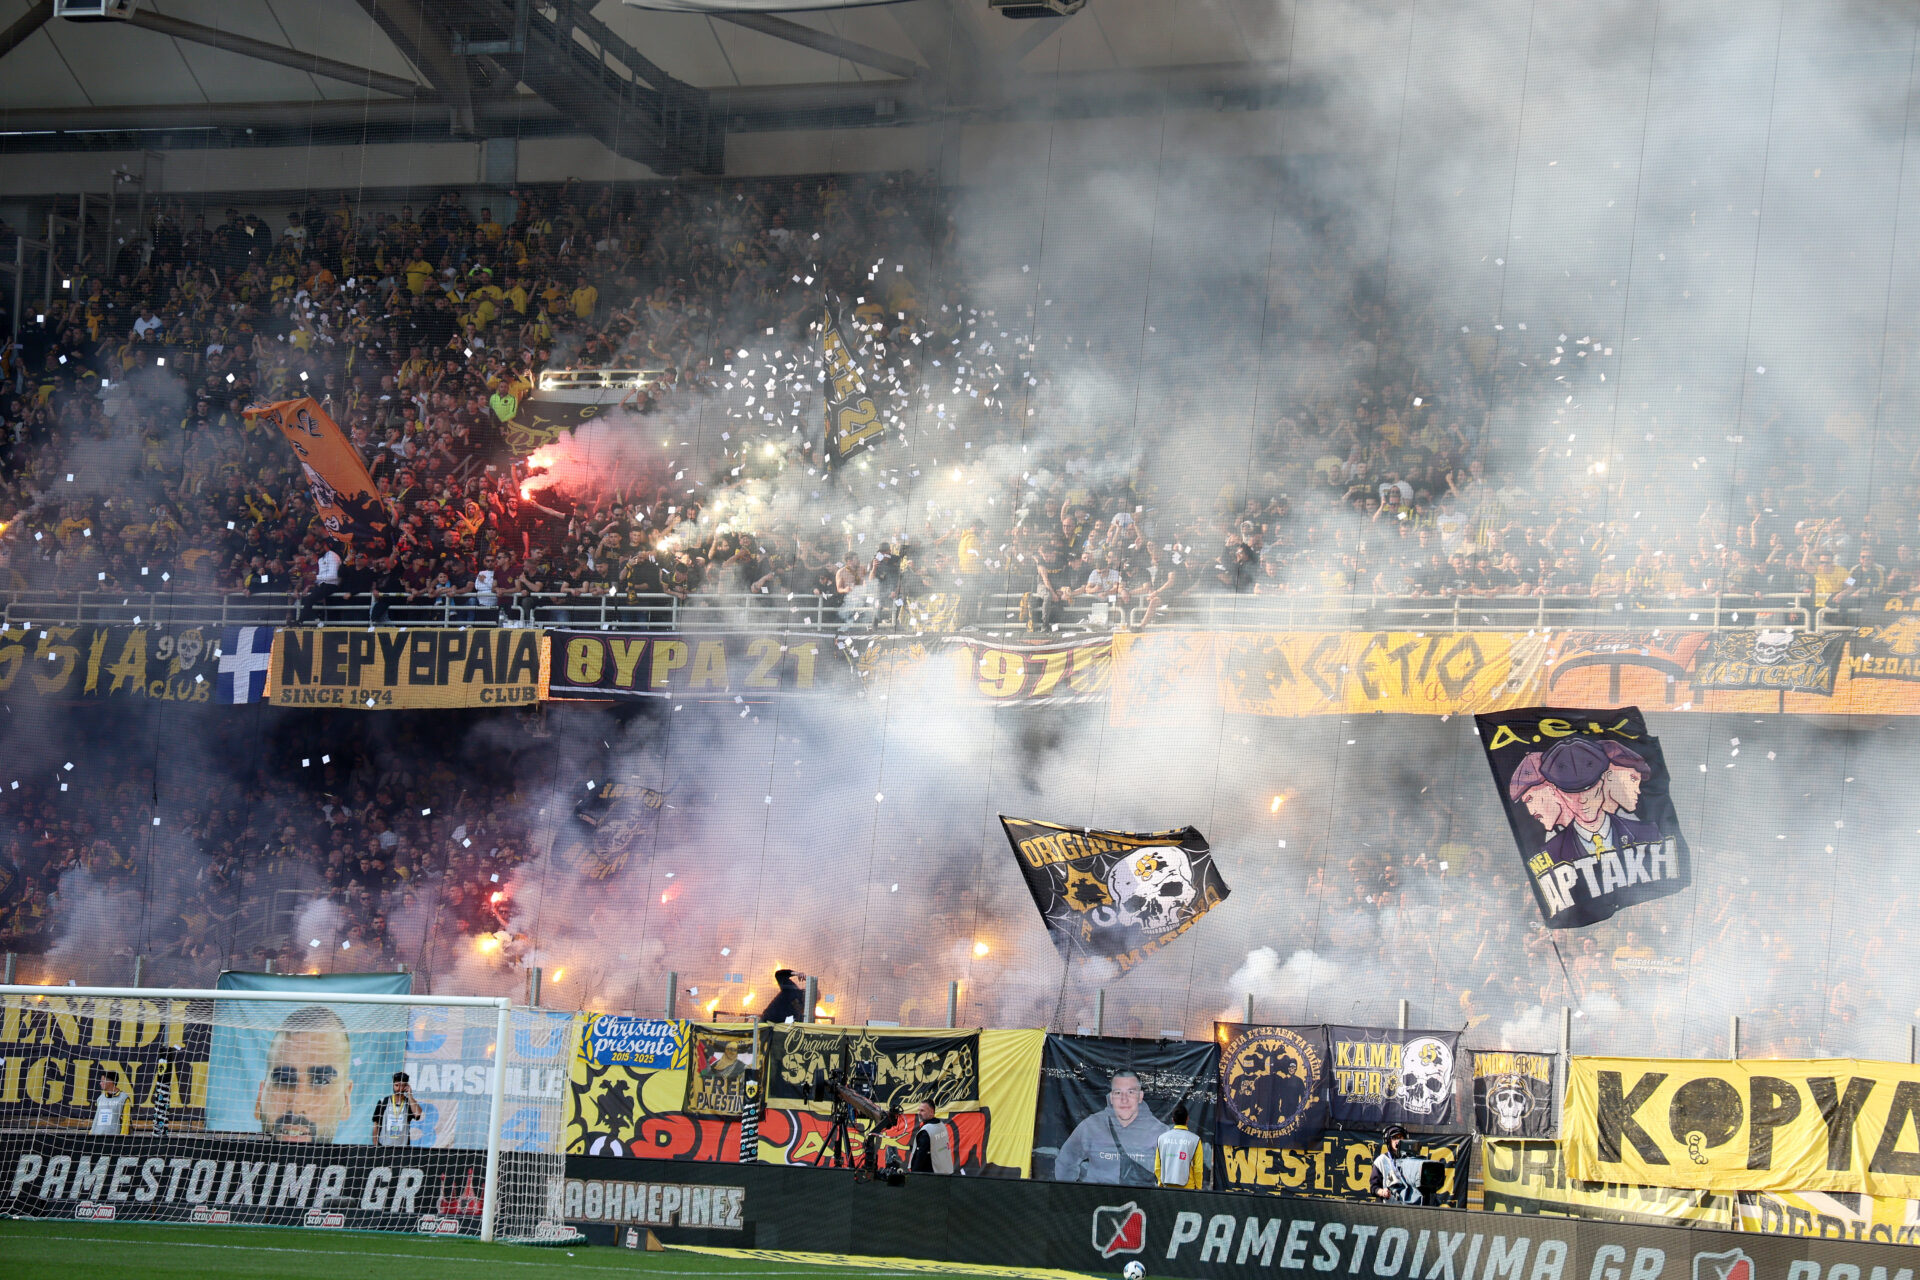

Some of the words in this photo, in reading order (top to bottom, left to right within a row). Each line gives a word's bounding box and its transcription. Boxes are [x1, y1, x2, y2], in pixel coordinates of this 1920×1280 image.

[743, 638, 817, 689] 21
[281, 688, 344, 704] SINCE
[350, 689, 393, 704] 1974
[480, 687, 537, 704] CLUB
[1020, 832, 1136, 868] ORIGIN
[1536, 837, 1681, 919] ΑΡΤΑΚΗ
[594, 1015, 679, 1038] Christine
[784, 1026, 847, 1060] Original
[594, 1035, 674, 1058] présente
[1336, 1041, 1403, 1068] KAMA
[781, 1050, 964, 1085] SANICA
[697, 1091, 744, 1113] PALESTIN
[702, 1075, 744, 1095] FRE
[887, 1083, 935, 1111] Ghost
[932, 1076, 976, 1108] Club
[9, 1154, 347, 1209] PAMESTOIXIMA
[361, 1166, 424, 1213] GR
[1223, 1141, 1333, 1191] WEST
[1345, 1142, 1457, 1197] GG
[1166, 1211, 1568, 1280] PAMESTOIXIMA
[1589, 1244, 1666, 1280] GR
